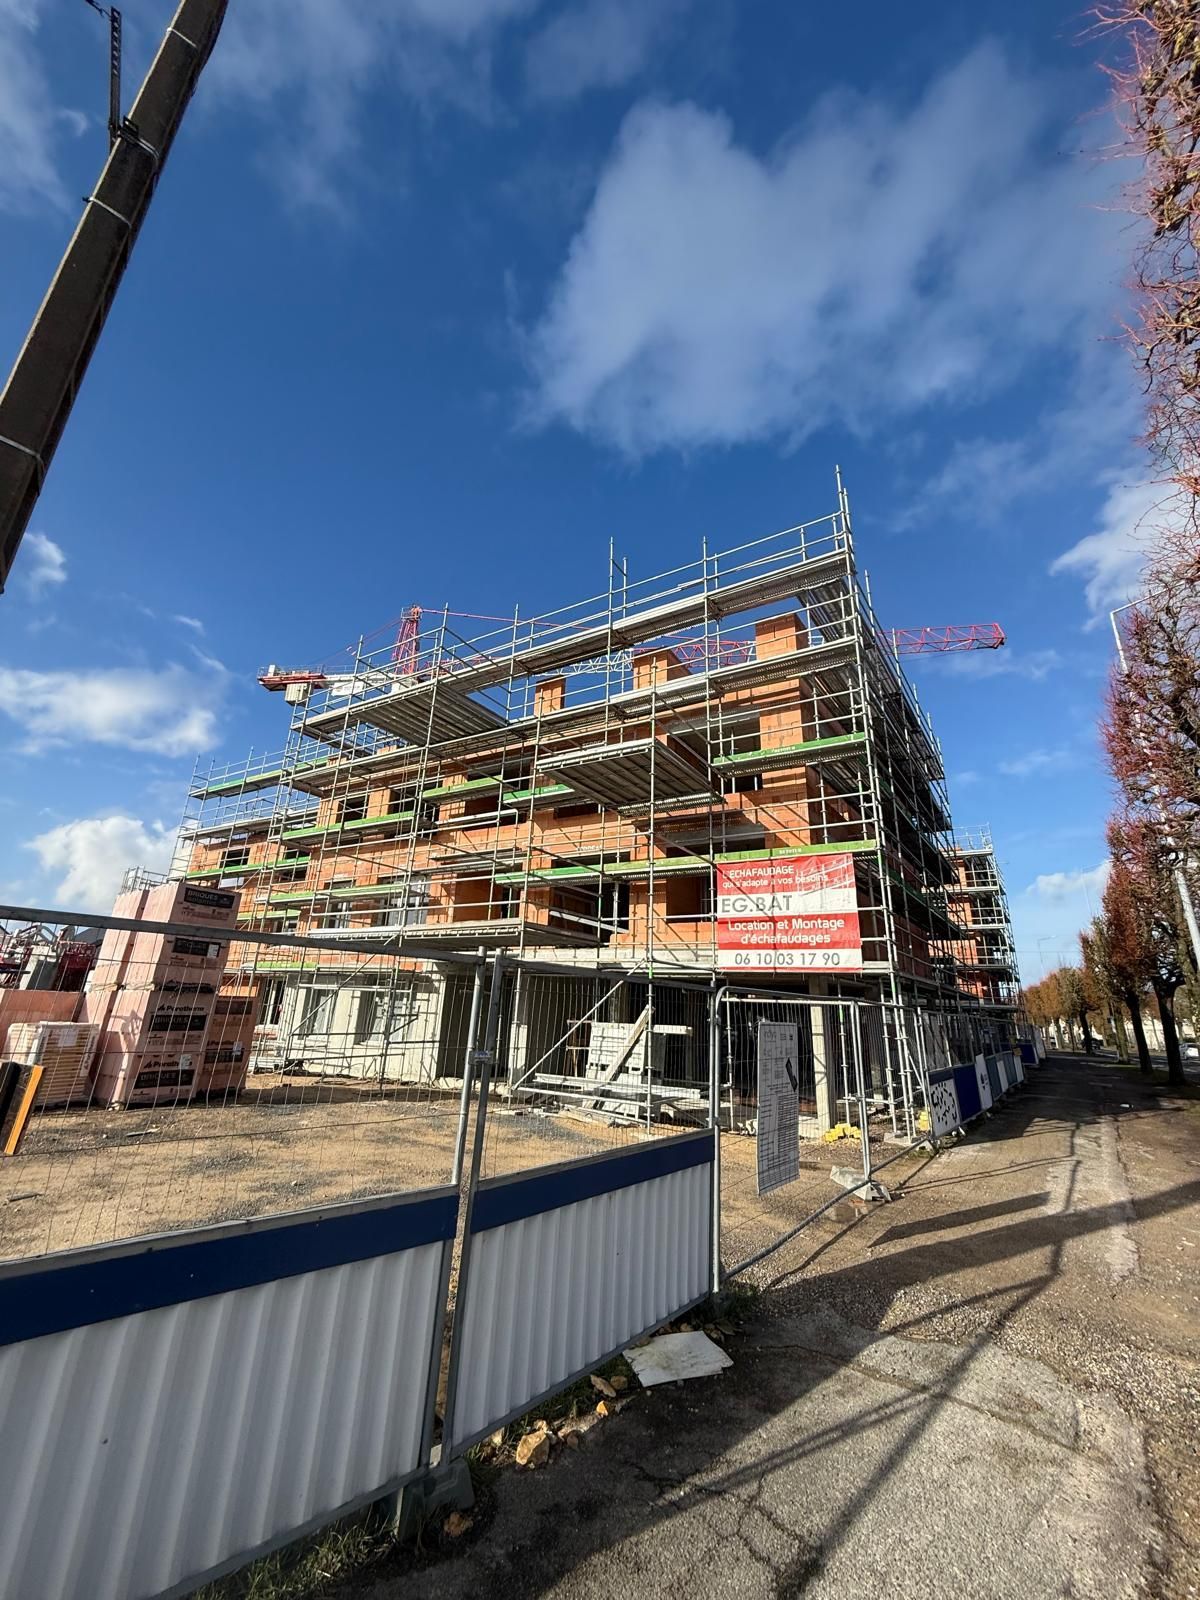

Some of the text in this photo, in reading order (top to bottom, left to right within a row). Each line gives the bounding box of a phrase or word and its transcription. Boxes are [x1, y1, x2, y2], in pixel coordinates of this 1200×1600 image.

[777, 877, 794, 885] vos
[795, 873, 828, 885] besoins
[721, 895, 793, 913] EG.BAT
[728, 918, 845, 931] Location et Montage
[740, 933, 832, 946] d'échafaudages
[735, 952, 840, 966] 06 10 03 17 90
